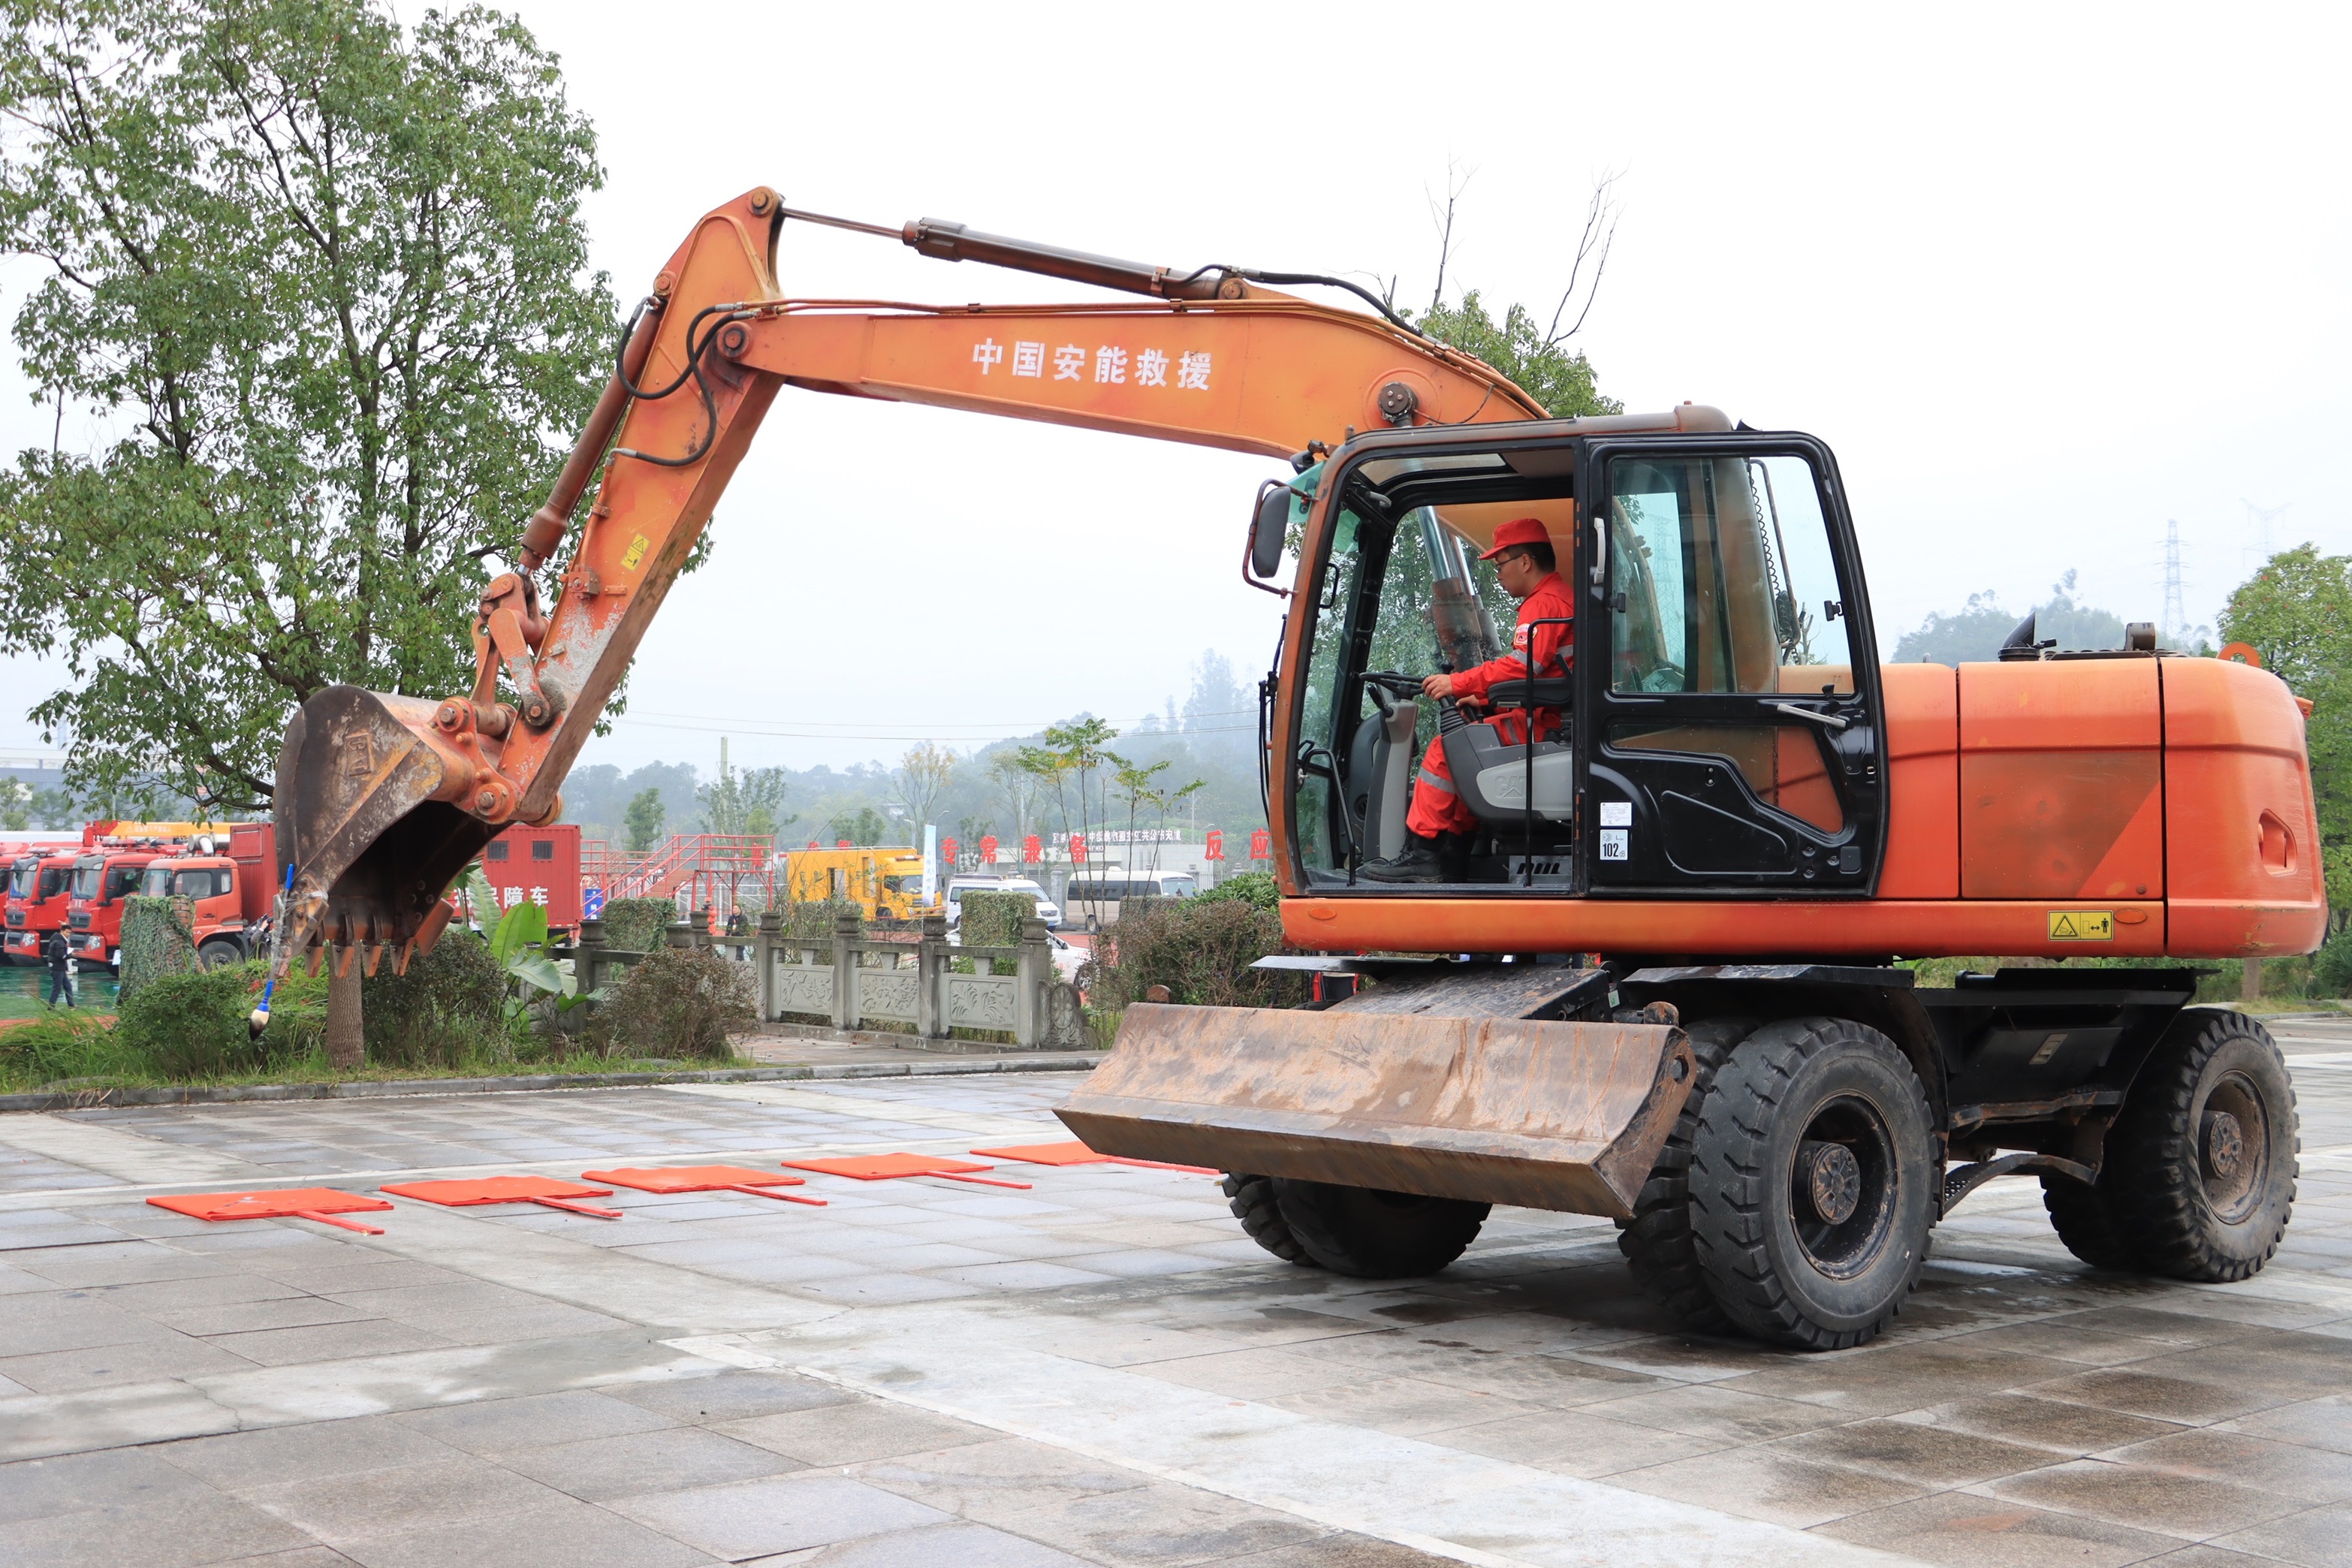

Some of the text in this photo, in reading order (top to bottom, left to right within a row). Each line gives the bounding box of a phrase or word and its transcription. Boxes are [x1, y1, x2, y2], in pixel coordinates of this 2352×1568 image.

[972, 337, 1212, 390] 中国安能救援
[939, 827, 1271, 865] 专常兼备 反应
[1603, 843, 1618, 857] 102
